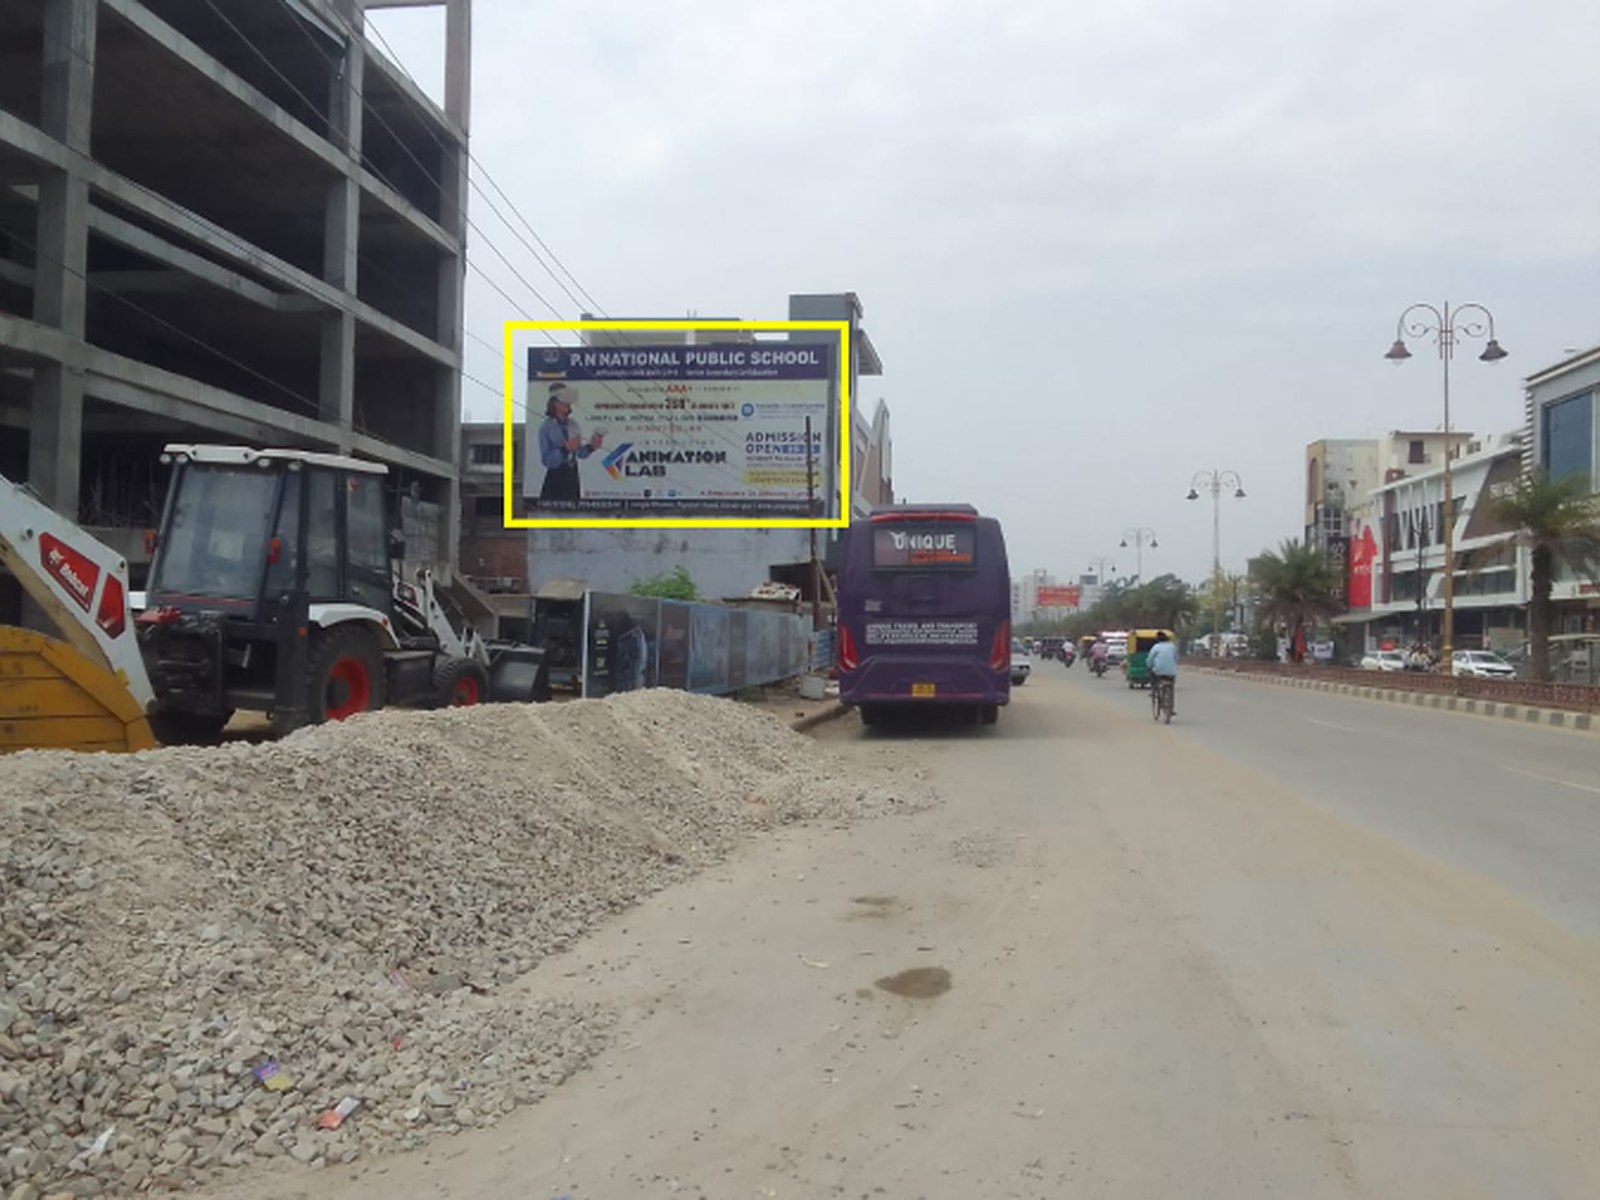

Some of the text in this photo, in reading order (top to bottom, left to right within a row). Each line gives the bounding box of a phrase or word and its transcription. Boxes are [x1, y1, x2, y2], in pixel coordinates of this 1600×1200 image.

[600, 352, 680, 366] NATIONAL
[686, 351, 745, 365] PUBLIC
[750, 351, 819, 365] SCHOOL
[745, 443, 780, 454] OPEN
[625, 451, 726, 463] ANIMATION
[625, 466, 666, 477] LAB
[889, 530, 955, 549] UNIQUE
